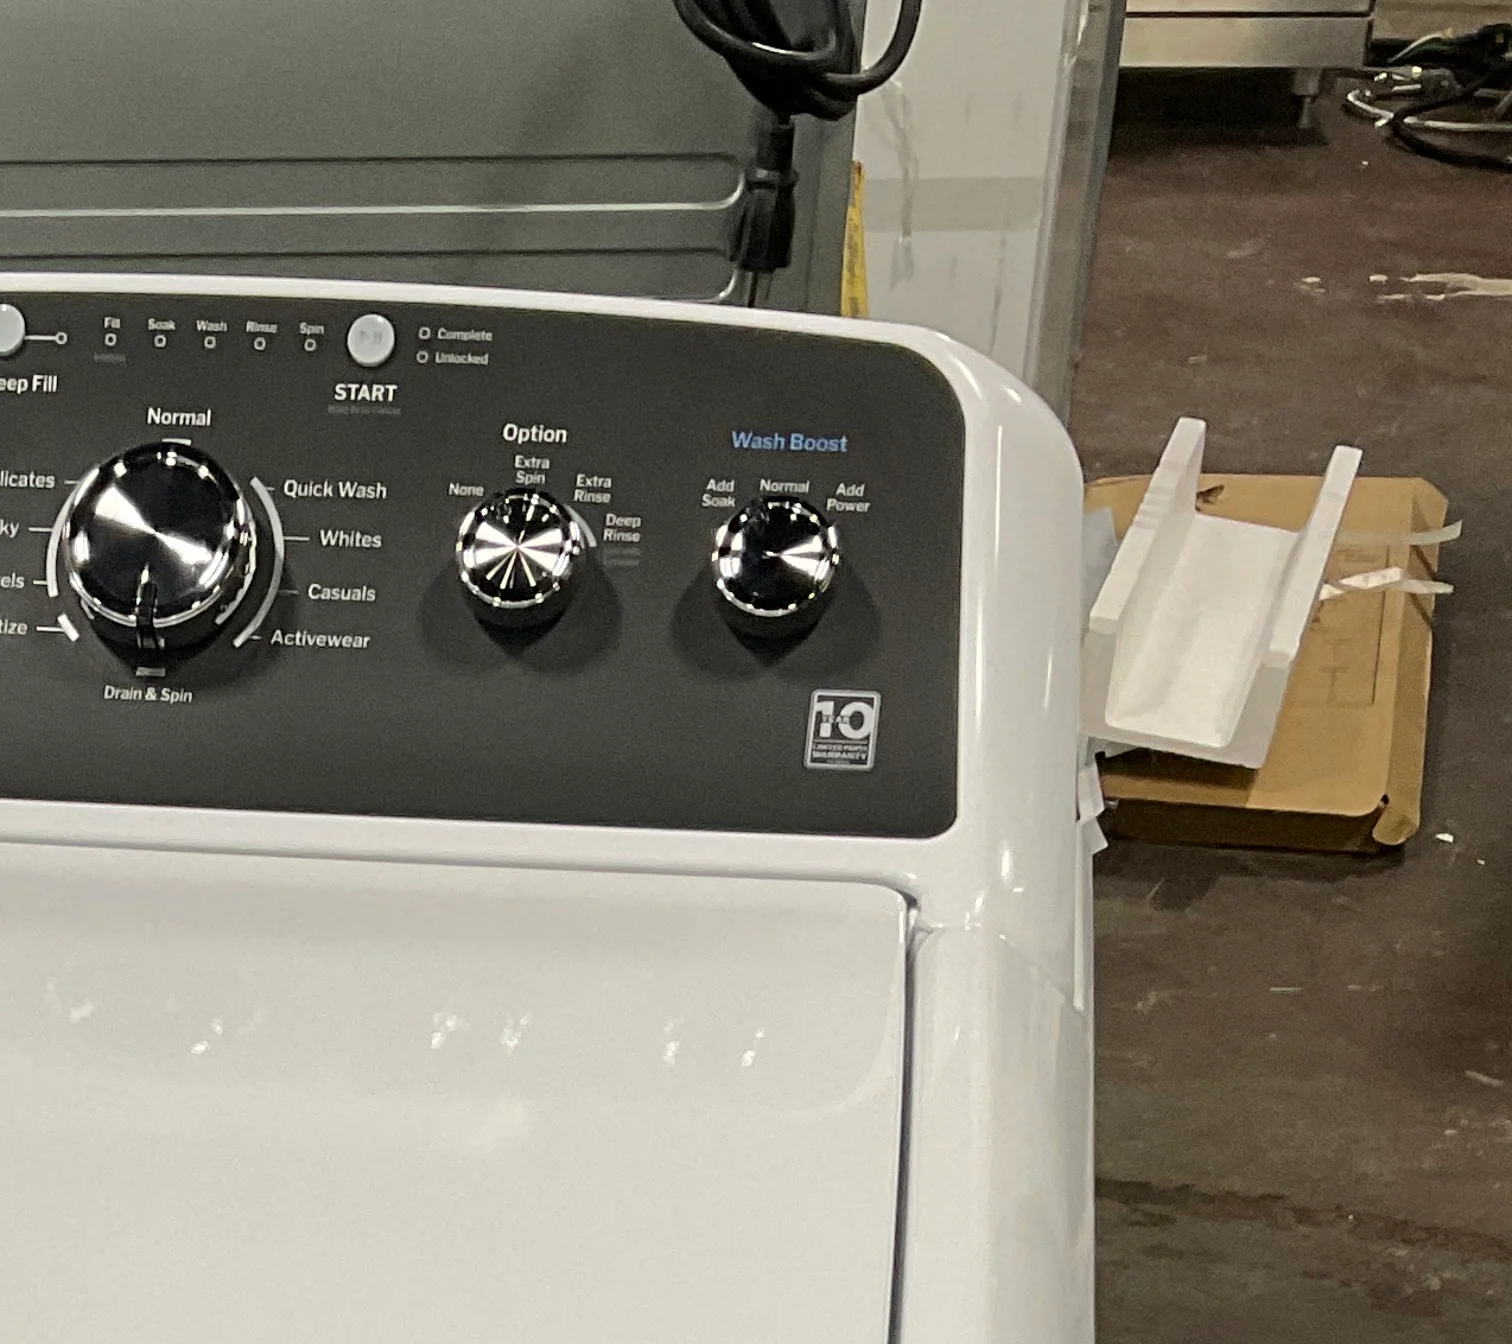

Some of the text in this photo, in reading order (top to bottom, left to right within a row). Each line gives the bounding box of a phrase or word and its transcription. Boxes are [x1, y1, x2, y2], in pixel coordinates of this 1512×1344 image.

[104, 317, 121, 329] Fill
[147, 318, 176, 331] Soak
[196, 319, 228, 333] Wash
[246, 320, 278, 333] Rinse
[299, 322, 325, 335] Spin
[437, 327, 493, 342] Complete
[435, 352, 489, 366] Unlocked
[32, 375, 58, 393] Fill
[334, 383, 398, 401] START
[147, 407, 212, 426] Normal
[502, 423, 567, 444] Option
[732, 430, 848, 452] Wash Boost
[514, 455, 550, 469] Extra
[515, 471, 545, 485] Spin
[576, 474, 612, 489] Extra
[283, 479, 387, 499] Quick Wash
[448, 483, 484, 497] None
[706, 479, 735, 492] Add
[760, 479, 810, 493] Normal
[836, 483, 865, 497] Add
[574, 489, 611, 503] Rinse
[702, 494, 736, 508] Soak
[826, 498, 871, 513] Power
[606, 513, 641, 528] Deep
[320, 529, 382, 548] Whites
[603, 528, 641, 542] Rinse
[308, 583, 376, 602] Casuals
[270, 629, 371, 648] Activewear
[103, 685, 193, 704] Drain & Spin
[814, 700, 874, 739] 10
